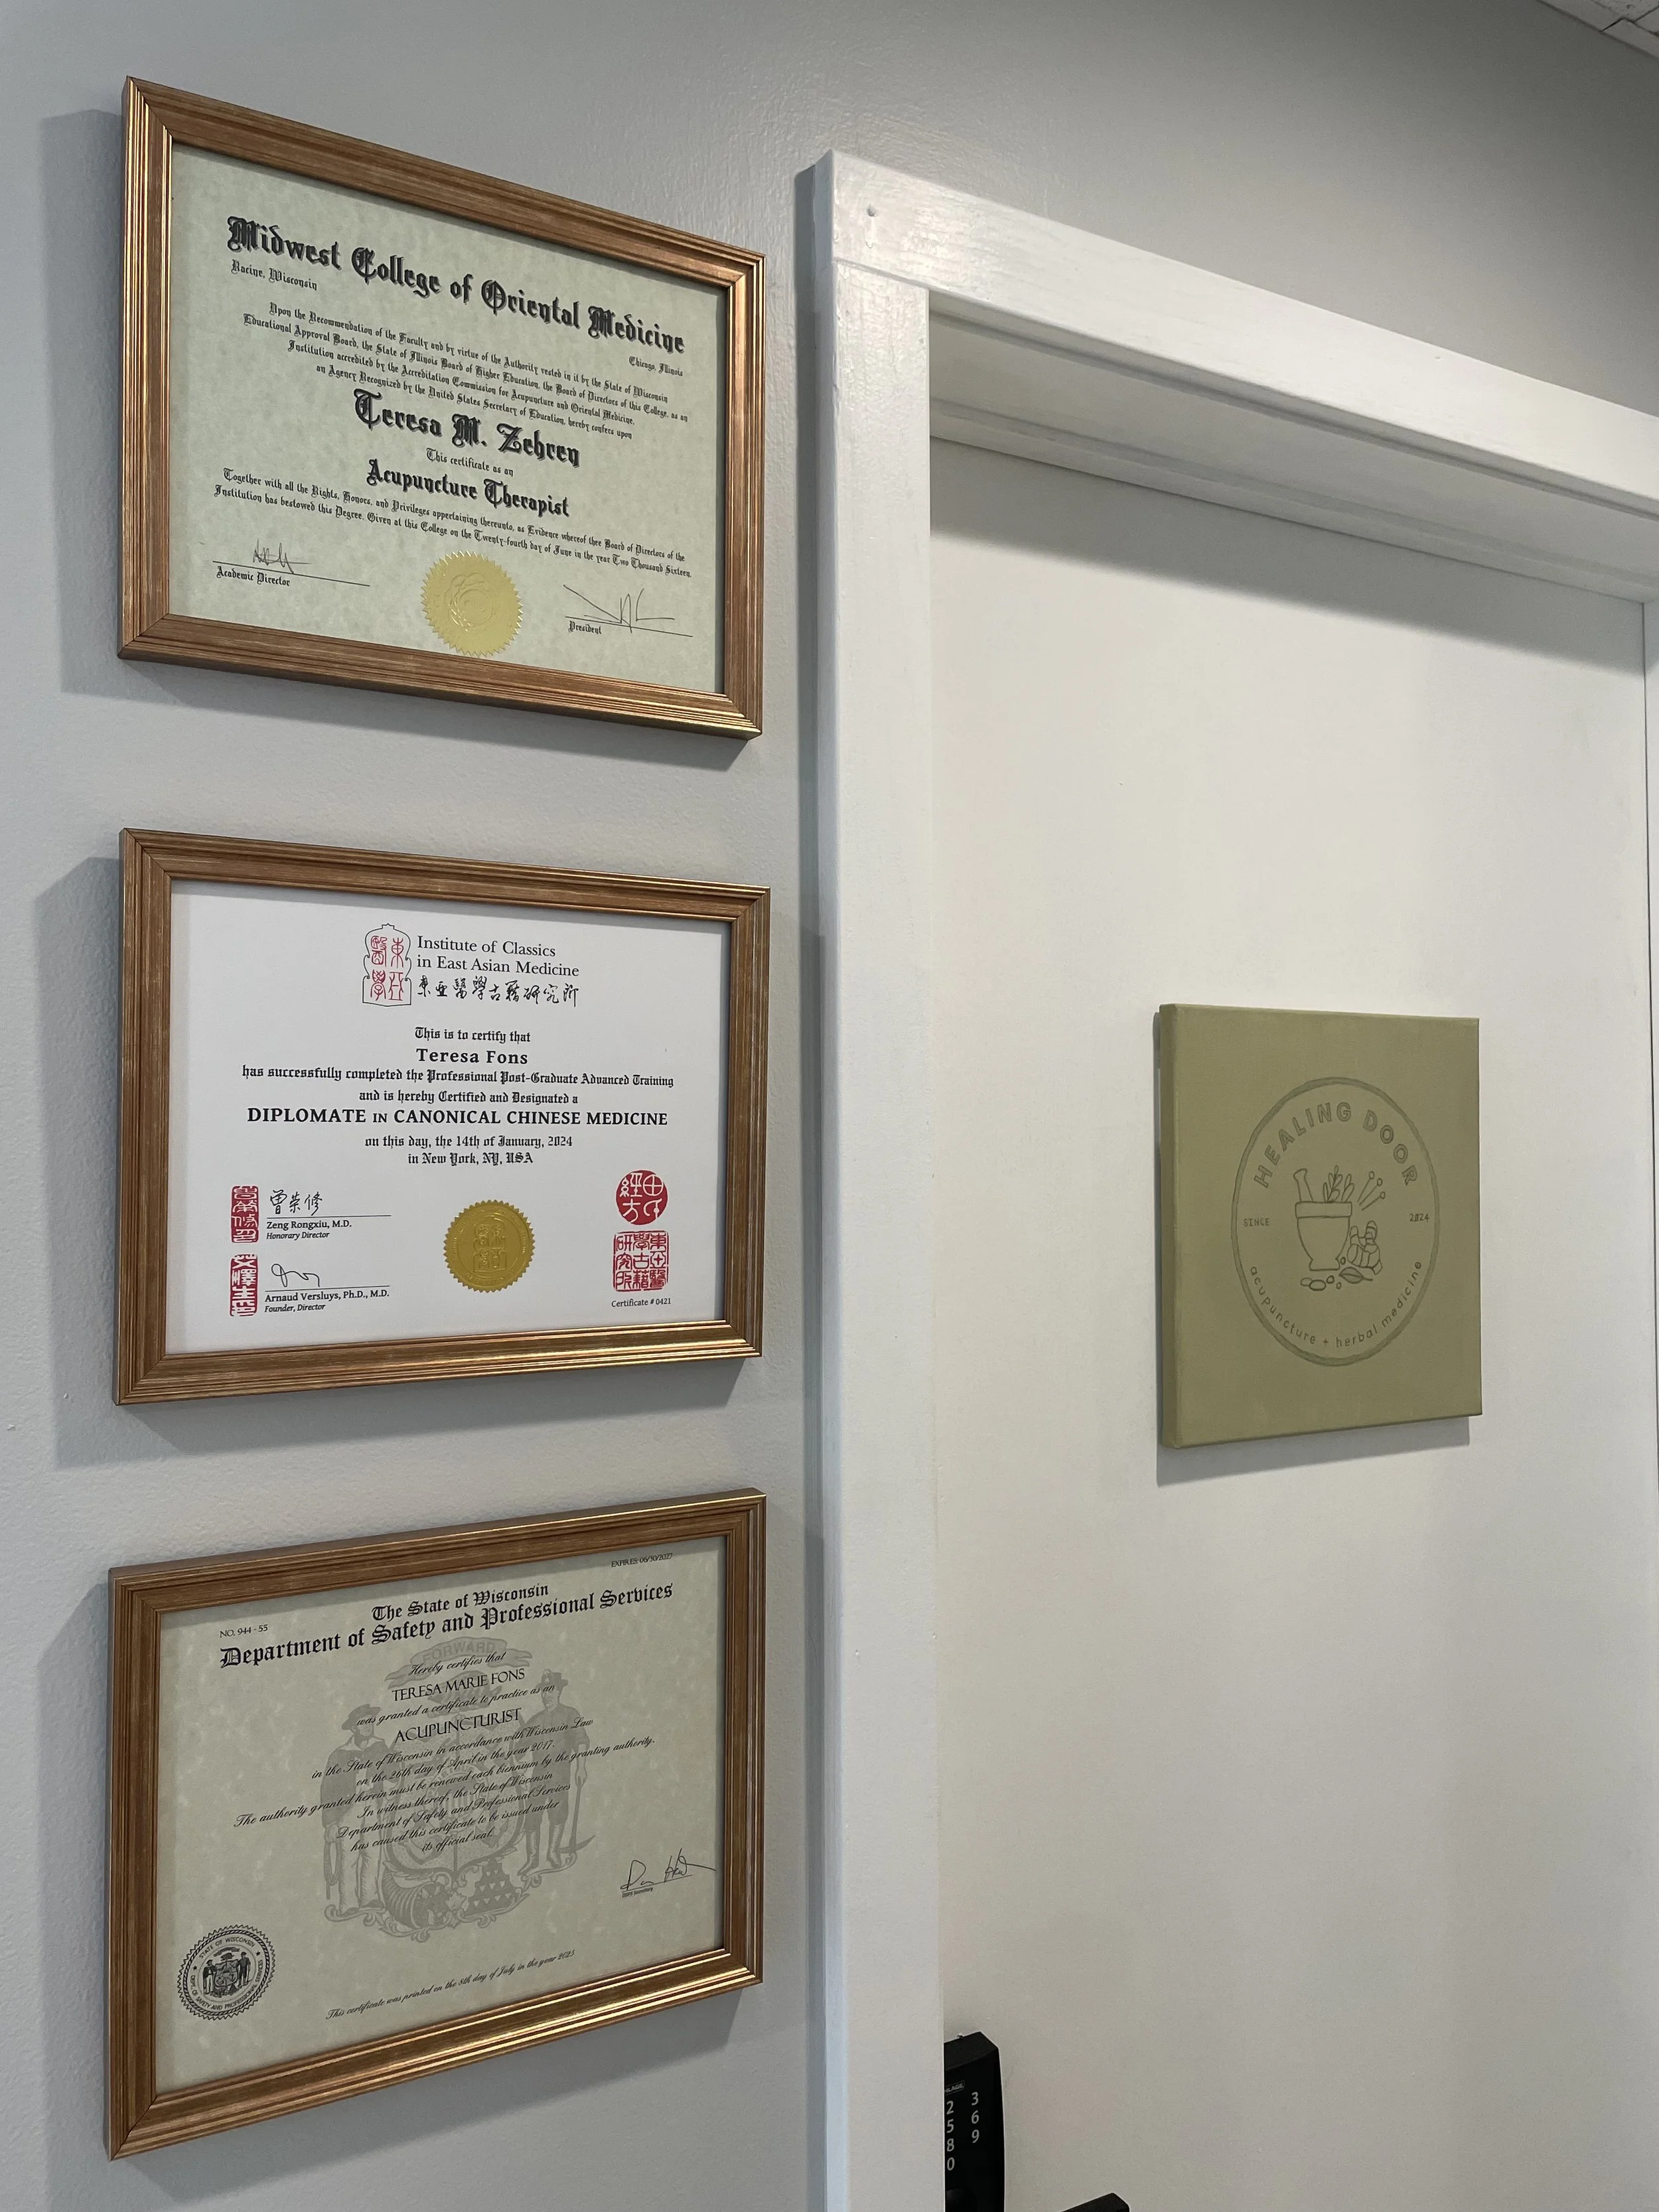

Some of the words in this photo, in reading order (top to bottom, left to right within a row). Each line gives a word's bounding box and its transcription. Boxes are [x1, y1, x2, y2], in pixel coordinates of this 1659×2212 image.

[226, 215, 341, 270] Midwest
[350, 246, 441, 299] College
[449, 273, 473, 303] of
[480, 279, 580, 329] Oriental
[587, 305, 685, 354] Medicine
[230, 258, 265, 278] Racine,
[268, 267, 317, 291] Wisconsin
[628, 355, 656, 372] Chicago,
[658, 362, 683, 376] Illinois
[316, 365, 325, 374] an
[328, 364, 356, 382] Agency
[358, 370, 401, 389] Recognized
[403, 380, 412, 394] by
[414, 384, 425, 394] the
[427, 385, 454, 400] United
[456, 392, 480, 406] States
[482, 398, 517, 417] Secretary
[519, 406, 526, 416] of
[528, 407, 565, 425] Education,
[567, 416, 589, 432] hereby
[591, 423, 614, 435] confers
[616, 430, 632, 439] upon
[353, 388, 442, 437] Teresa
[451, 413, 487, 448] M.
[496, 422, 579, 468] Zehren
[425, 447, 447, 463] This
[450, 457, 489, 471] certificate
[504, 468, 513, 477] an
[366, 457, 478, 500] Acupuncture
[483, 478, 569, 518] Therapist
[216, 565, 253, 581] Academic
[256, 571, 290, 586] Director
[567, 620, 602, 634] President
[417, 934, 477, 952] Institute
[481, 940, 498, 953] of
[502, 940, 555, 957] Classics
[417, 954, 431, 968] in
[437, 955, 467, 970] East
[470, 958, 510, 972] Asian
[515, 960, 579, 976] Medicine
[414, 1026, 440, 1041] This
[443, 1028, 454, 1039] is
[457, 1029, 468, 1040] to
[471, 1030, 506, 1044] certify
[509, 1030, 530, 1044] that
[415, 1048, 479, 1063] Teresa
[486, 1050, 528, 1065] Fons
[242, 1064, 263, 1079] has
[267, 1066, 342, 1081] successfully
[345, 1067, 402, 1082] completed
[405, 1068, 423, 1082] the
[426, 1069, 497, 1083] Professional
[500, 1070, 578, 1084] Post-Graduate
[580, 1072, 629, 1085] Advanced
[632, 1074, 674, 1088] Training
[358, 1089, 380, 1100] and
[383, 1090, 394, 1100] is
[397, 1089, 435, 1104] hereby
[438, 1090, 486, 1102] Certified
[489, 1091, 508, 1102] and
[511, 1091, 569, 1105] Designated
[247, 1107, 366, 1122] DIPLOMATE
[372, 1112, 388, 1123] IN
[394, 1109, 500, 1124] CANONICAL
[506, 1110, 581, 1124] CHINESE
[586, 1112, 668, 1125] MEDICINE
[364, 1138, 379, 1146] on
[382, 1134, 404, 1149] this
[408, 1135, 431, 1149] day,
[435, 1134, 453, 1149] the
[456, 1135, 480, 1149] 14th
[482, 1136, 496, 1146] of
[497, 1134, 544, 1149] January,
[547, 1136, 572, 1146] 2024
[1254, 1102, 1351, 1187] HEALING
[1363, 1110, 1417, 1186] DOOR
[407, 1153, 418, 1164] in
[421, 1151, 446, 1164] New
[449, 1151, 478, 1166] York,
[482, 1151, 502, 1166] NY,
[505, 1151, 533, 1163] USA
[266, 1221, 289, 1231] Zeng
[290, 1219, 330, 1230] Rongxiu,
[331, 1219, 352, 1228] M.D.
[1244, 1218, 1270, 1226] SINCE
[265, 1232, 300, 1240] Honorary
[264, 1291, 298, 1302] Arnaud
[299, 1290, 341, 1301] Versluys,
[342, 1289, 368, 1299] Ph.D.,
[370, 1289, 389, 1297] M.D.
[611, 1297, 648, 1307] Certificate
[1250, 1266, 1316, 1345] acupuncture
[1336, 1324, 1378, 1348] herbal
[1382, 1261, 1421, 1327] medicine
[264, 1303, 295, 1313] Founder,
[371, 1605, 402, 1622] The
[407, 1599, 450, 1617] State
[455, 1593, 468, 1608] of
[472, 1585, 548, 1606] Wisconsin
[219, 1629, 236, 1638] NO.
[258, 1623, 268, 1633] 55
[220, 1633, 340, 1668] Department
[348, 1627, 365, 1647] of
[371, 1620, 435, 1645] Safety
[441, 1612, 474, 1633] and
[480, 1592, 595, 1630] Professional
[599, 1582, 673, 1609] Services
[407, 1660, 443, 1676] Hereby
[446, 1655, 482, 1670] certifies
[484, 1651, 506, 1662] that
[391, 1683, 442, 1701] TERESA
[445, 1674, 488, 1692] MARIE
[491, 1667, 524, 1684] FONS
[394, 1707, 522, 1743] ACUPUNCTURIST
[233, 1812, 257, 1827] The
[259, 1805, 308, 1822] authority
[307, 1793, 355, 1816] granted
[354, 1789, 386, 1803] herein
[388, 1783, 415, 1796] must
[415, 1780, 427, 1790] be
[428, 1770, 472, 1787] renewed
[471, 1765, 494, 1779] each
[496, 1761, 538, 1774] biennium
[541, 1754, 551, 1767] by
[555, 1751, 568, 1762] the
[569, 1745, 611, 1762] granting
[613, 1735, 654, 1751] authority.
[946, 2101, 954, 2115] 2
[971, 2091, 979, 2106] 3
[946, 2118, 954, 2134] 5
[971, 2110, 979, 2124] 6
[946, 2138, 955, 2152] 8
[972, 2129, 980, 2144] 9
[947, 2157, 955, 2171] 0
